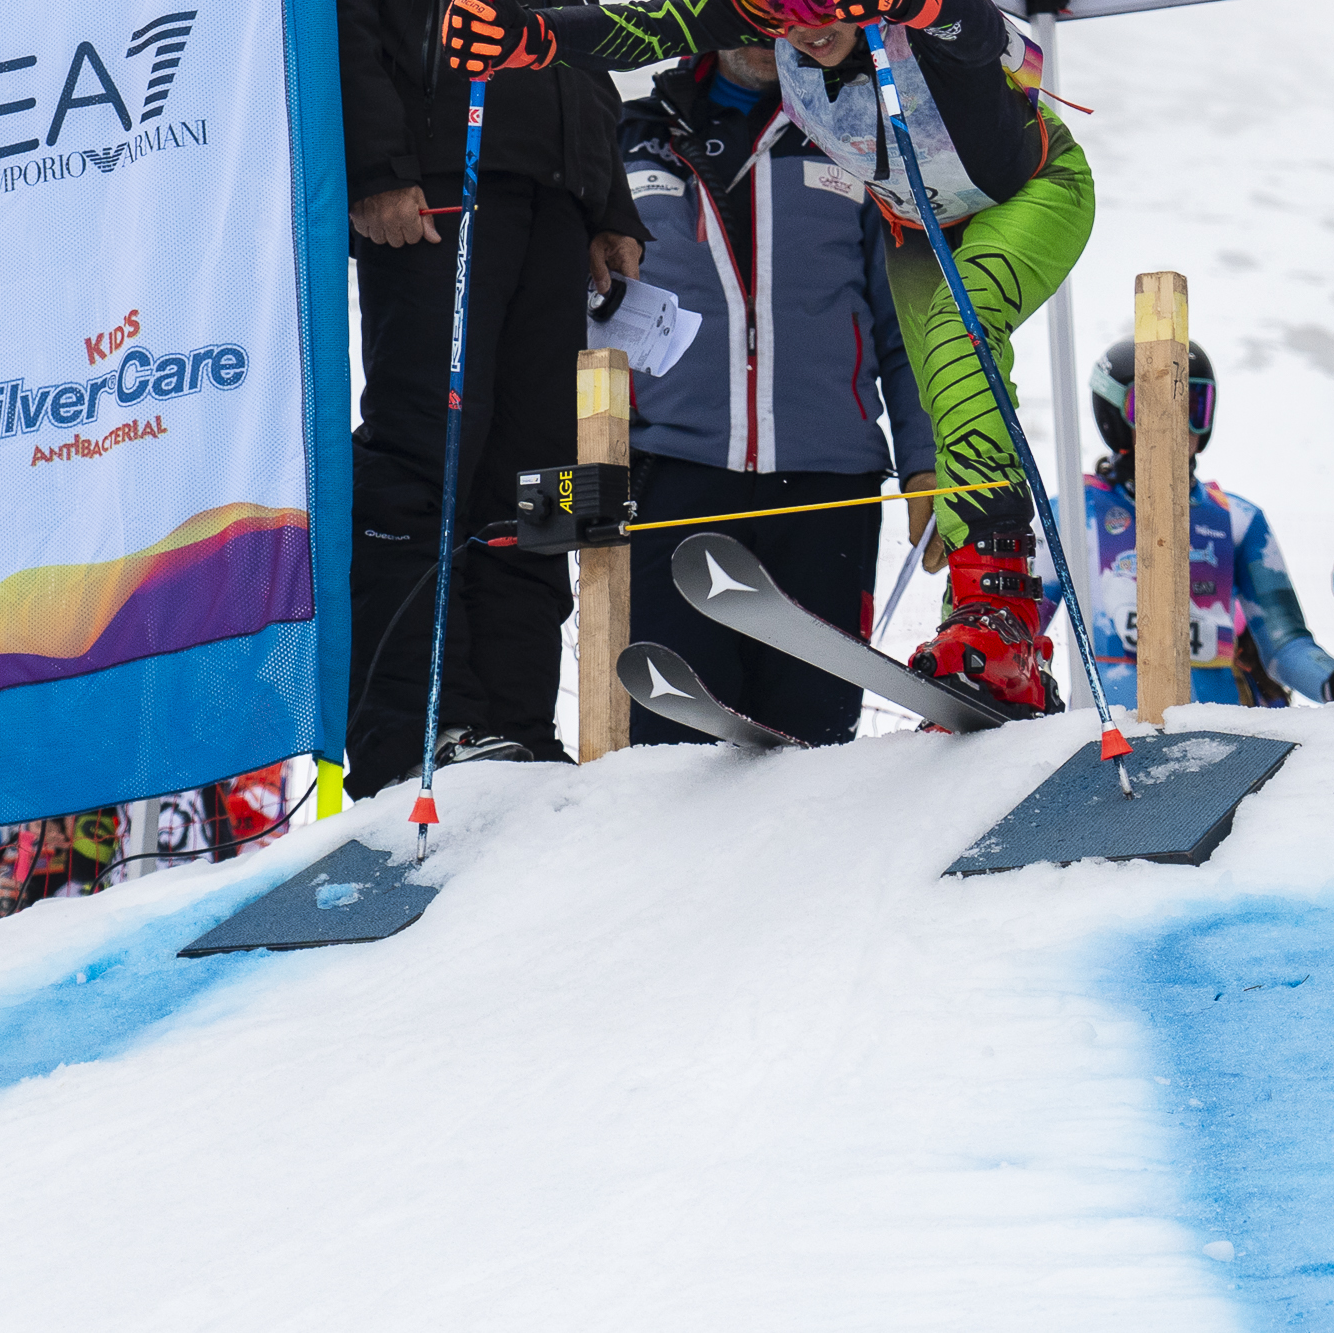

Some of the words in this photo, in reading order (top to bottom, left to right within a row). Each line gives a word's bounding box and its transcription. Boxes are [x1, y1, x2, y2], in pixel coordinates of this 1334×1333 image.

[120, 118, 210, 168] ARMANI
[84, 308, 142, 366] KID'S
[30, 414, 169, 467] ANTIBACTERIAL
[559, 470, 573, 514] ALGE
